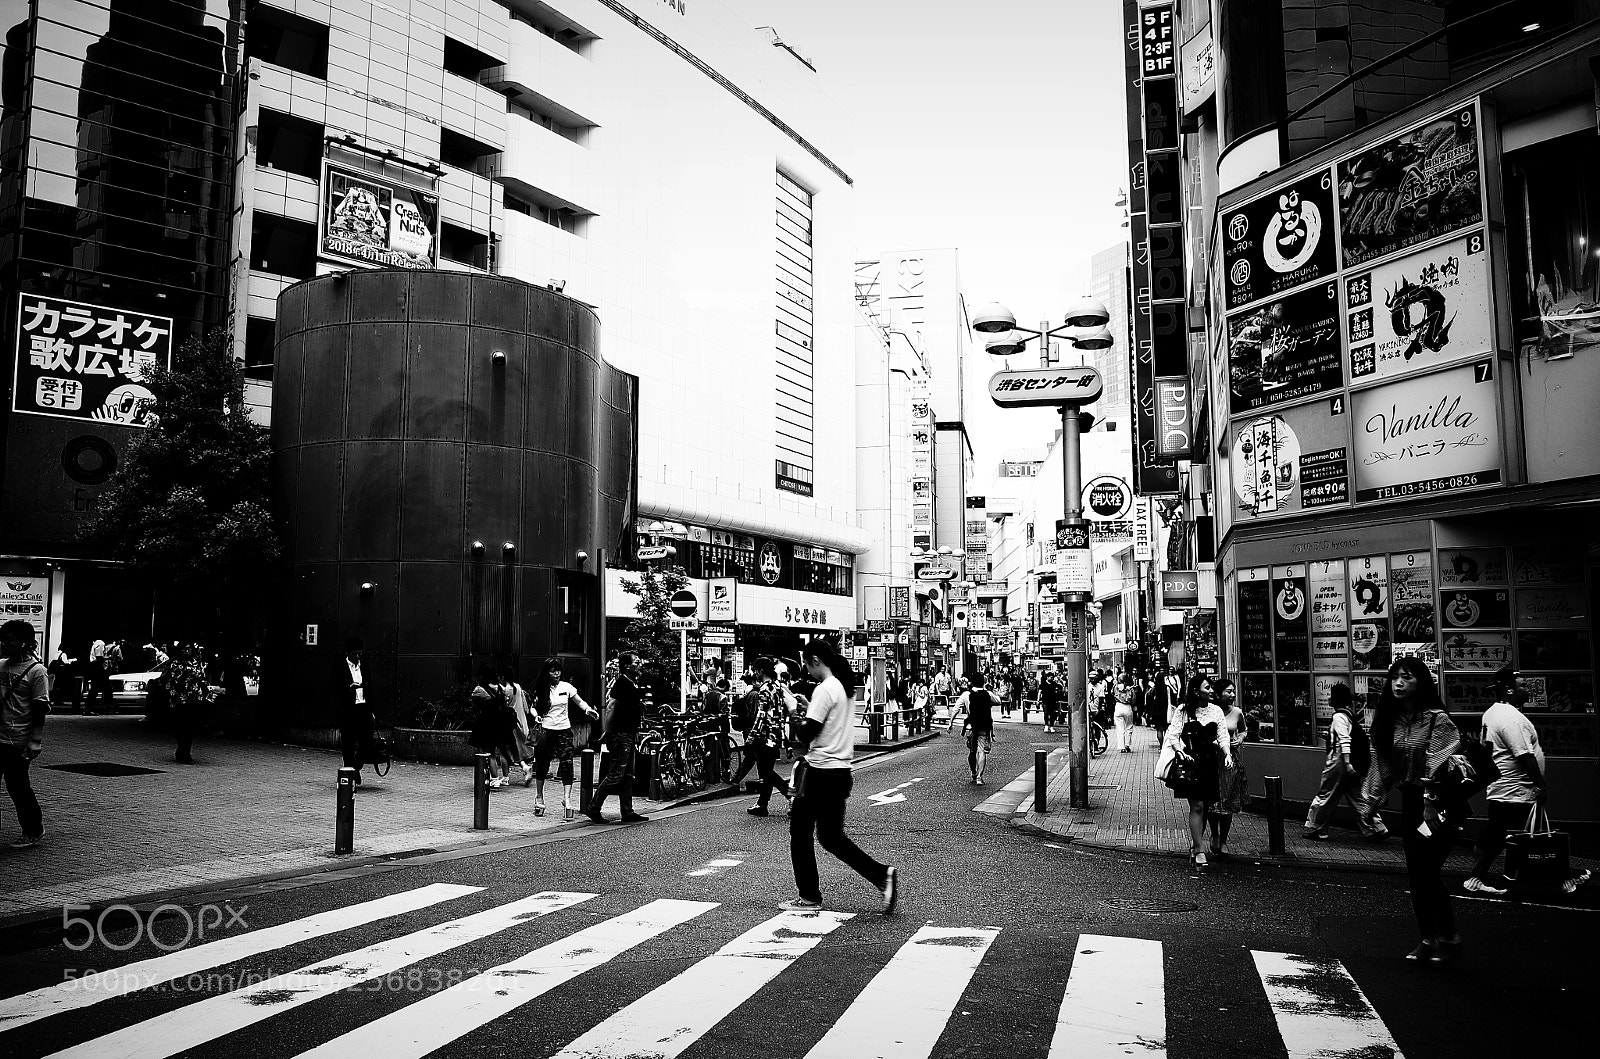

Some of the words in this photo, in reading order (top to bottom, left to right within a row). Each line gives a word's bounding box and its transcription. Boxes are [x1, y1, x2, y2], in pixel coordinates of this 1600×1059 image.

[1144, 13, 1156, 25] 5
[1160, 11, 1171, 24] F
[1144, 28, 1157, 40] 4
[1161, 26, 1171, 39] F
[1145, 57, 1173, 71] B1F
[1461, 111, 1472, 127] 9
[1320, 172, 1331, 190] 6
[400, 219, 425, 237] Nuts
[1471, 236, 1481, 253] 8
[1282, 264, 1319, 283] HARUKA
[1419, 256, 1459, 284] 焼肉
[1327, 284, 1335, 299] 5
[23, 301, 169, 350] カラオケ
[30, 334, 158, 384] 歌広場
[1477, 363, 1489, 381] 7
[40, 379, 79, 394] 受付
[996, 374, 1096, 392] 渋谷センター街
[42, 392, 75, 408] 5F
[1333, 398, 1342, 413] 4
[1366, 395, 1479, 444] Vanilla
[1399, 439, 1446, 461] バニラ
[1256, 430, 1274, 507] 海千魚千
[1092, 492, 1122, 507] 消火栓
[1136, 502, 1147, 521] TAX
[1137, 523, 1148, 547] FREE
[1324, 562, 1330, 574] 7
[1364, 557, 1371, 569] 8
[1407, 554, 1415, 566] 9
[1250, 568, 1256, 580] 5
[1286, 566, 1293, 577] 6
[1164, 581, 1197, 592] P.D.C
[1315, 613, 1342, 624] Vanilla
